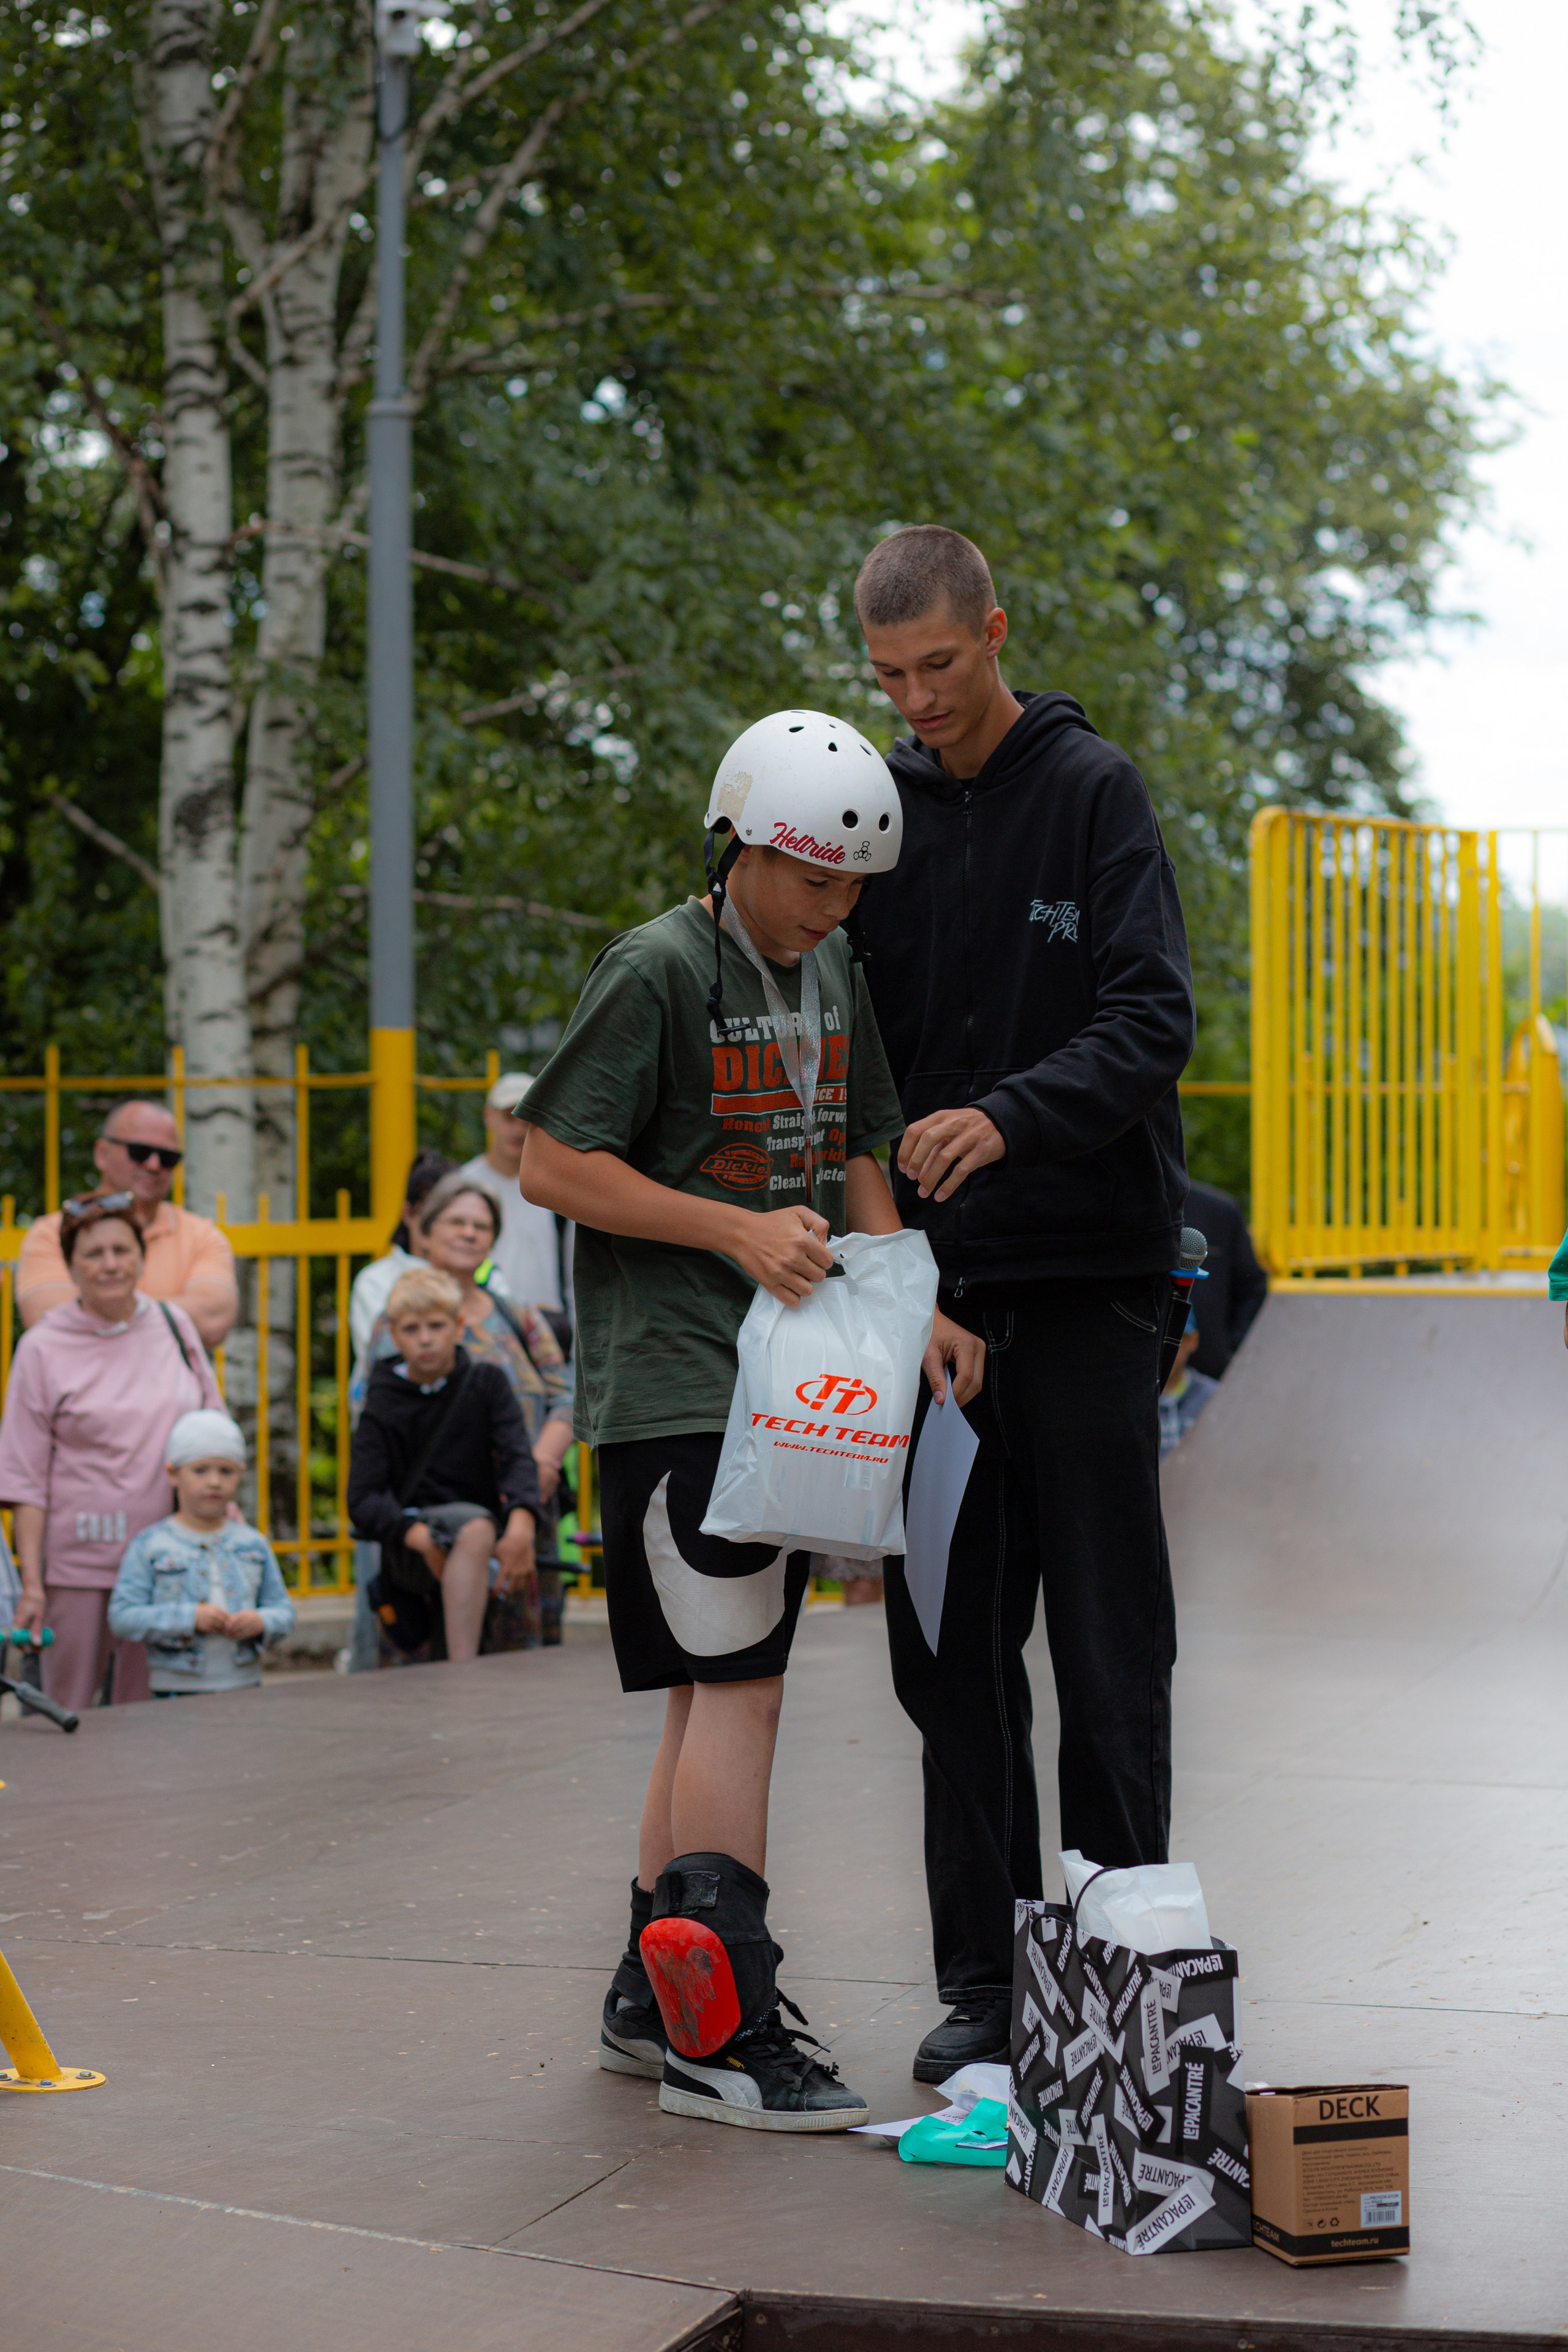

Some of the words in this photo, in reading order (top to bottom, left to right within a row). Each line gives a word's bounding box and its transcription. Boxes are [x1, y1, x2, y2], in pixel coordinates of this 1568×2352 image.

[769, 822, 846, 864] Hellride
[824, 1005, 841, 1031] of
[751, 1412, 830, 1437] TECH
[834, 1426, 910, 1449] TEAM
[773, 1441, 889, 1464] WWW.TECHTEAM.RU
[726, 2056, 742, 2068] PUMA
[1319, 2095, 1381, 2121] DECK
[1330, 2237, 1379, 2248] techteam.ru
